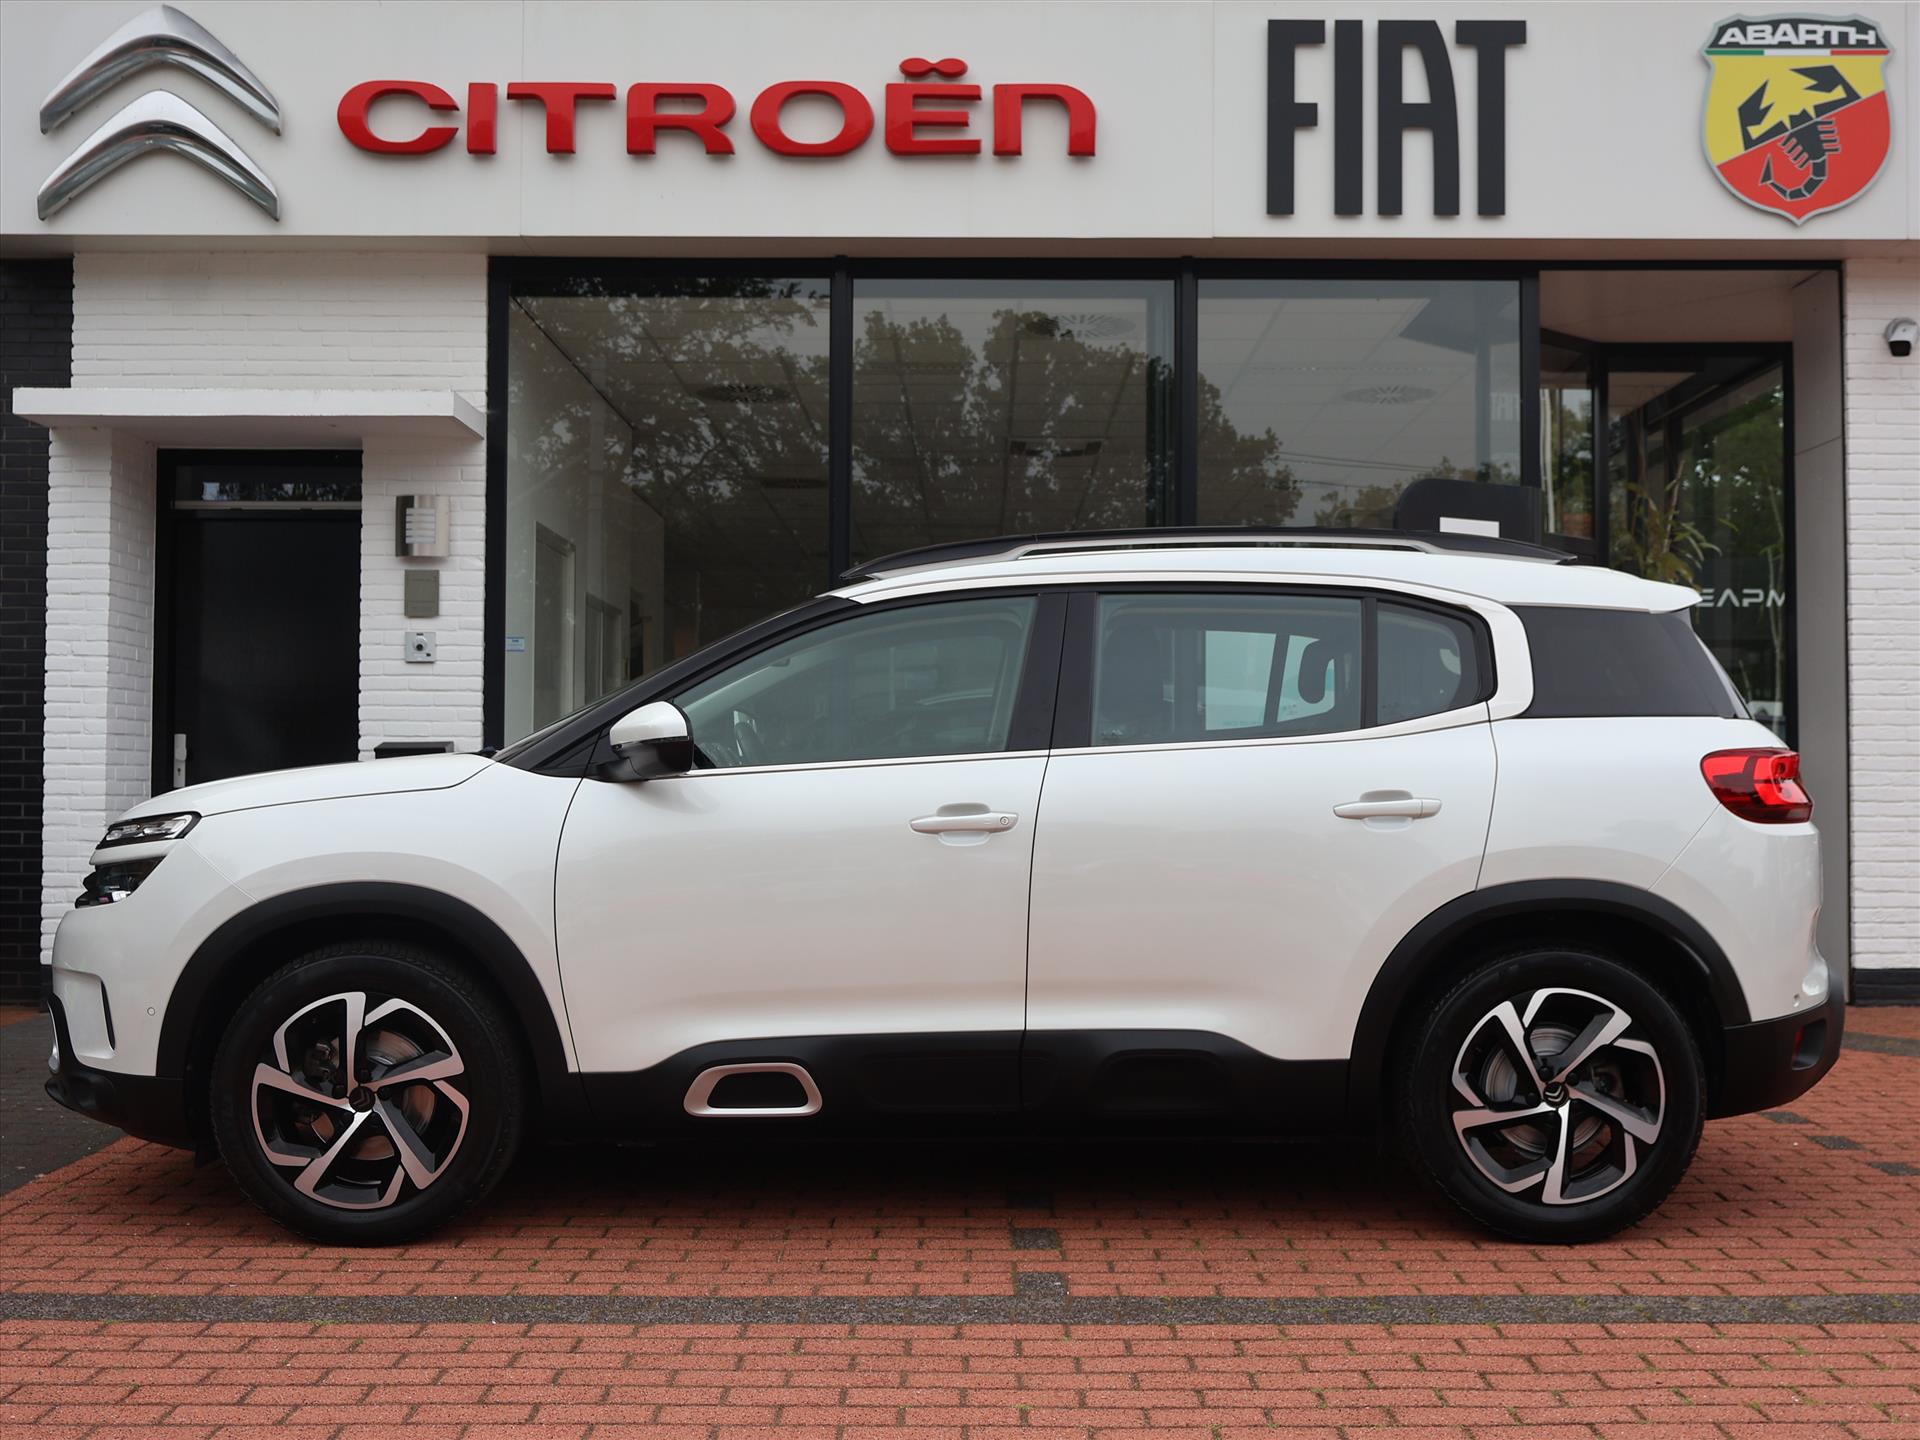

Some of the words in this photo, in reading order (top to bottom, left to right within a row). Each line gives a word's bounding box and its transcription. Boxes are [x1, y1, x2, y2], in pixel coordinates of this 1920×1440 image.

[1718, 22, 1877, 46] ABARTH
[338, 57, 1095, 157] CITROËN
[1266, 19, 1526, 217] FIAT
